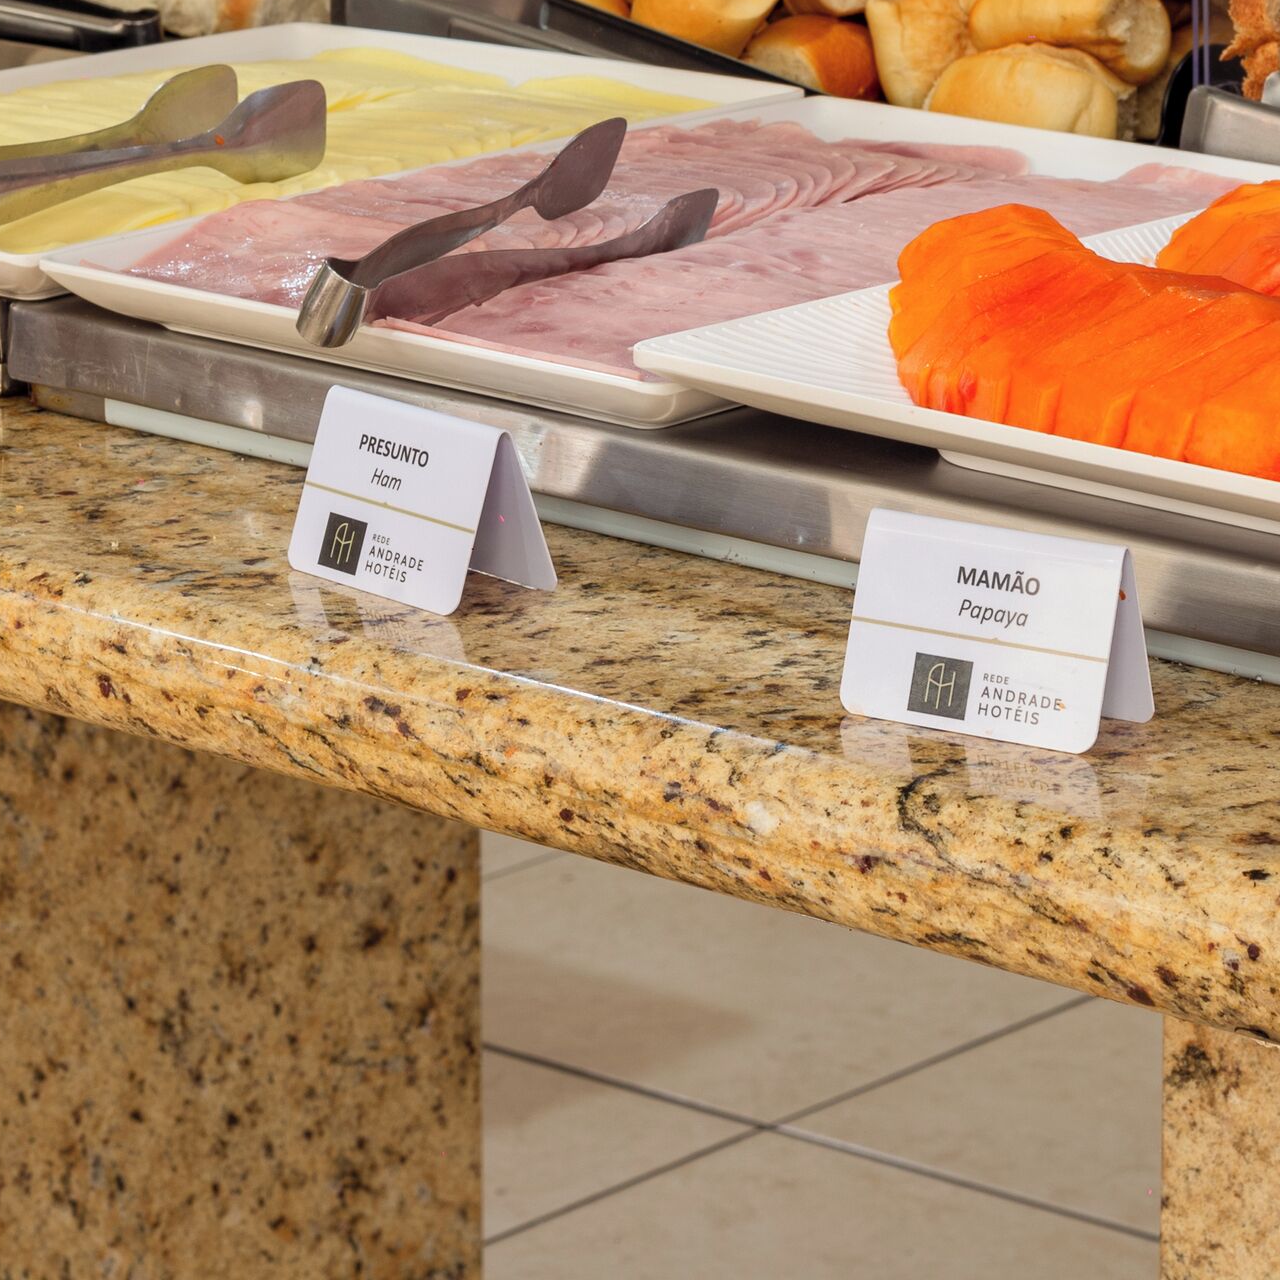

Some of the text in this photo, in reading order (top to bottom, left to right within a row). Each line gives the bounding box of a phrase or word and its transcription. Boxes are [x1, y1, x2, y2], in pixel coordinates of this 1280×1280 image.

[358, 433, 430, 468] PRESUNTO
[370, 467, 403, 492] Ham
[372, 533, 391, 546] REDE
[364, 559, 407, 583] HOTÉIS
[368, 545, 425, 572] ANDRADE
[956, 565, 1041, 596] MAMÃO
[957, 598, 1029, 629] Papaya
[982, 672, 1010, 686] REDE
[980, 685, 1063, 712] ANDRADE
[977, 702, 1041, 726] HOTÉIS
